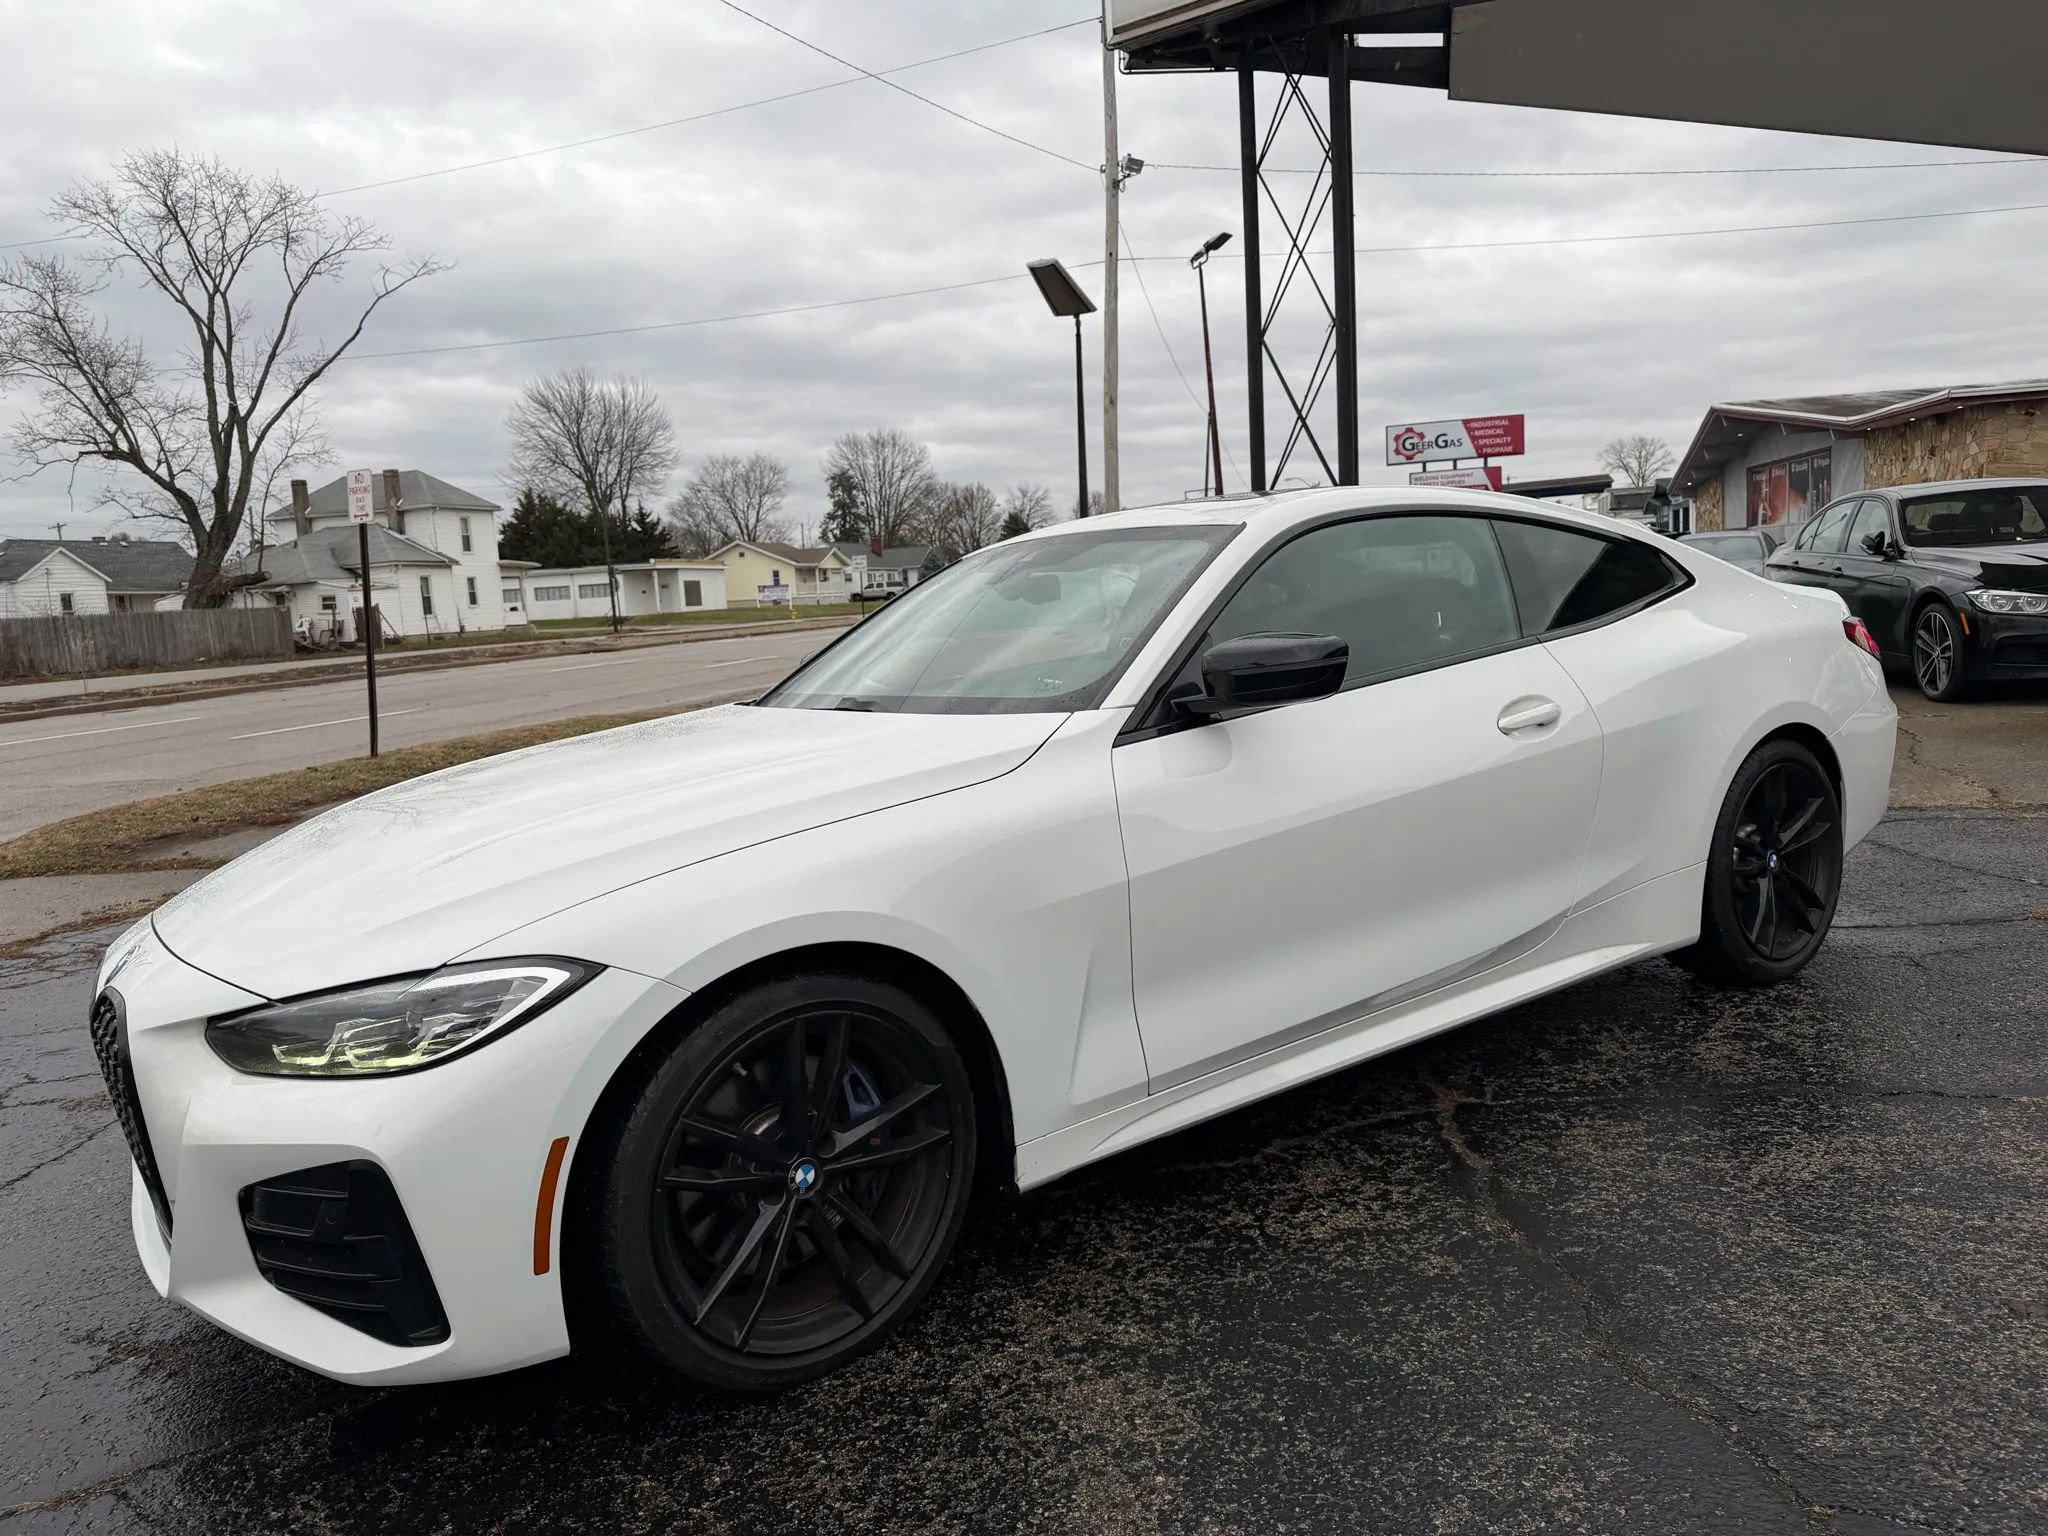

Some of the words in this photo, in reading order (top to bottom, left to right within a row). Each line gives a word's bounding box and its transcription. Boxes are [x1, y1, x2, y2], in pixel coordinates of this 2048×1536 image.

[1470, 419, 1509, 428] INDUSTRIAL
[1478, 437, 1511, 445] SPECIALTY
[1482, 446, 1513, 454] PROPANE
[354, 474, 364, 484] NO
[1440, 472, 1474, 480] EQUIPMENT
[348, 485, 371, 495] PARKING
